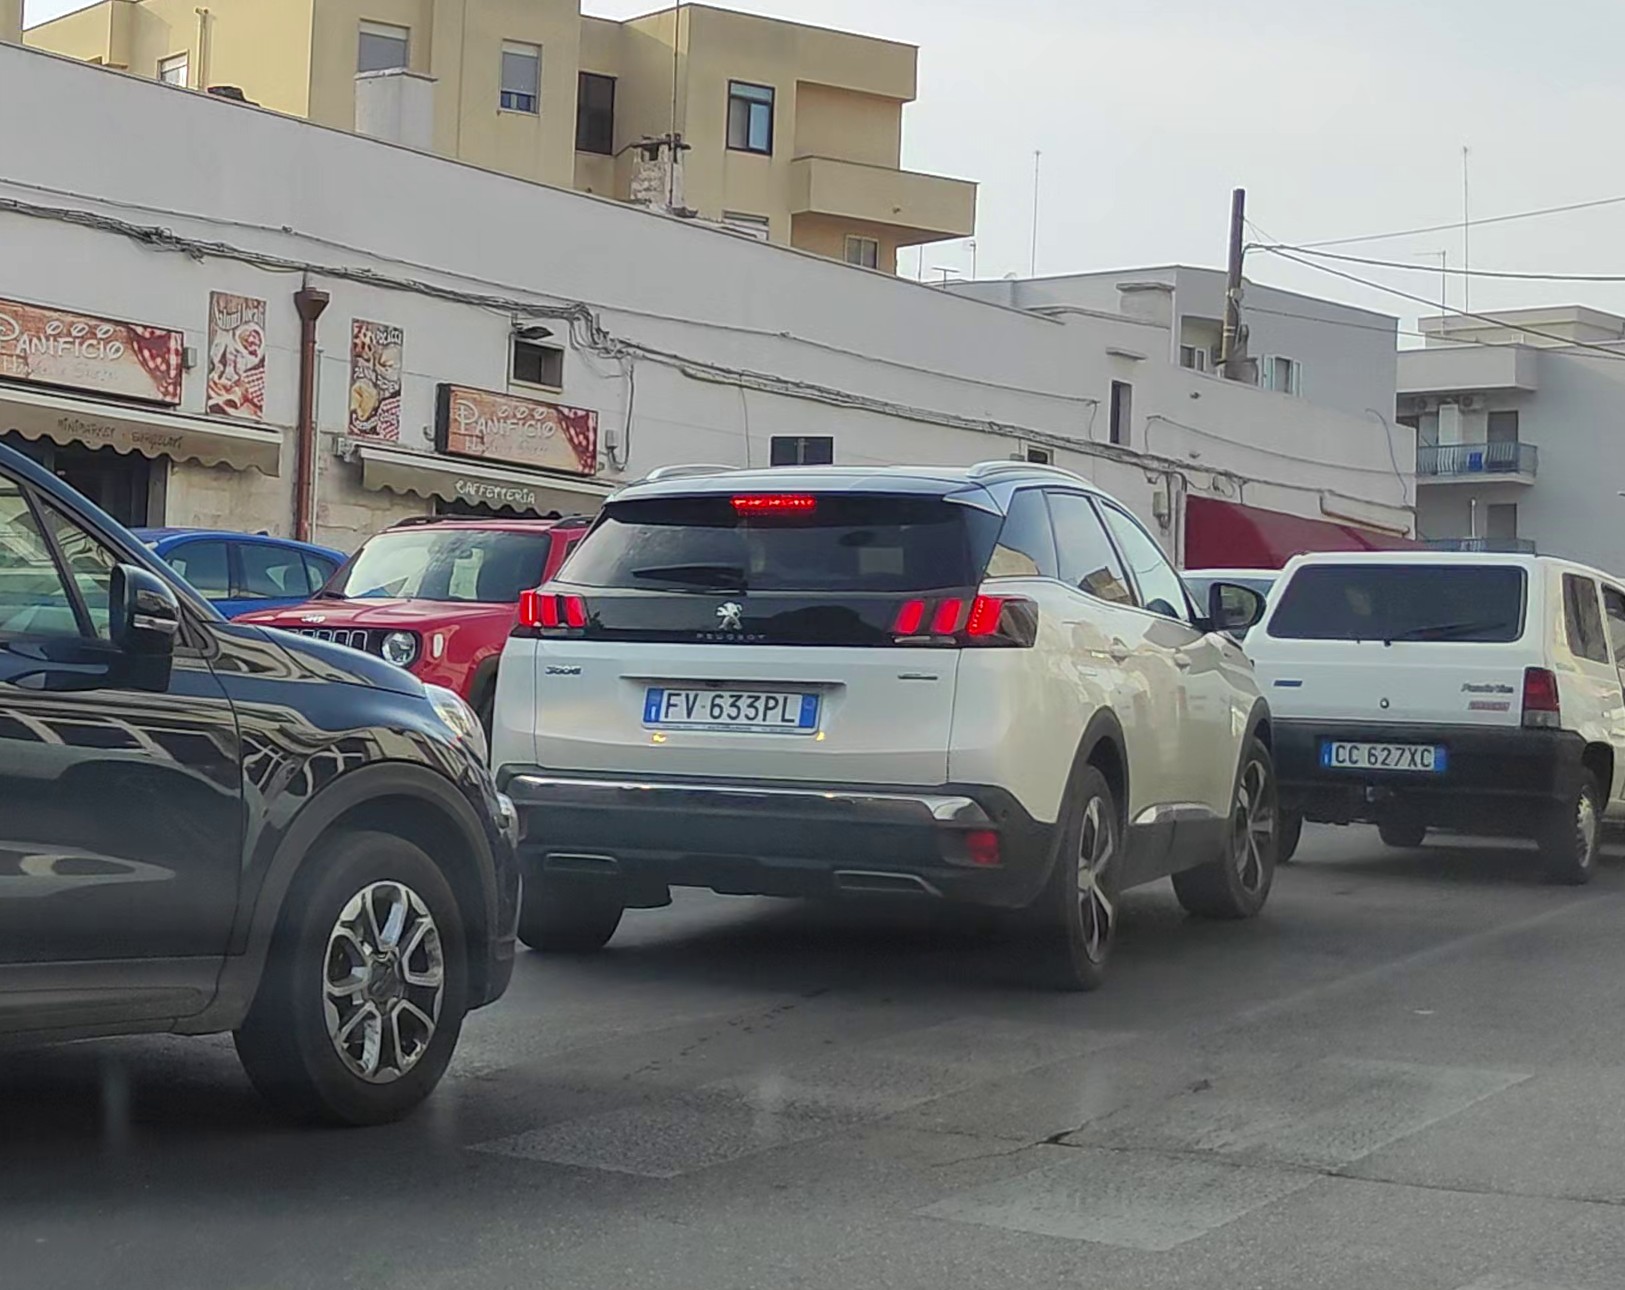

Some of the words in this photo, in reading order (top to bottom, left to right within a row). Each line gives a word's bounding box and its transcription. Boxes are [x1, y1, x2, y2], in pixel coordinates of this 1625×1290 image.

[455, 399, 556, 439] PANIFICIO
[455, 480, 536, 504] CAFFETTERIA
[696, 632, 767, 641] PEUGEOT
[664, 692, 699, 719] FV
[709, 694, 795, 723] 633PL
[1335, 744, 1359, 766] CC
[1367, 745, 1432, 768] 627XC
